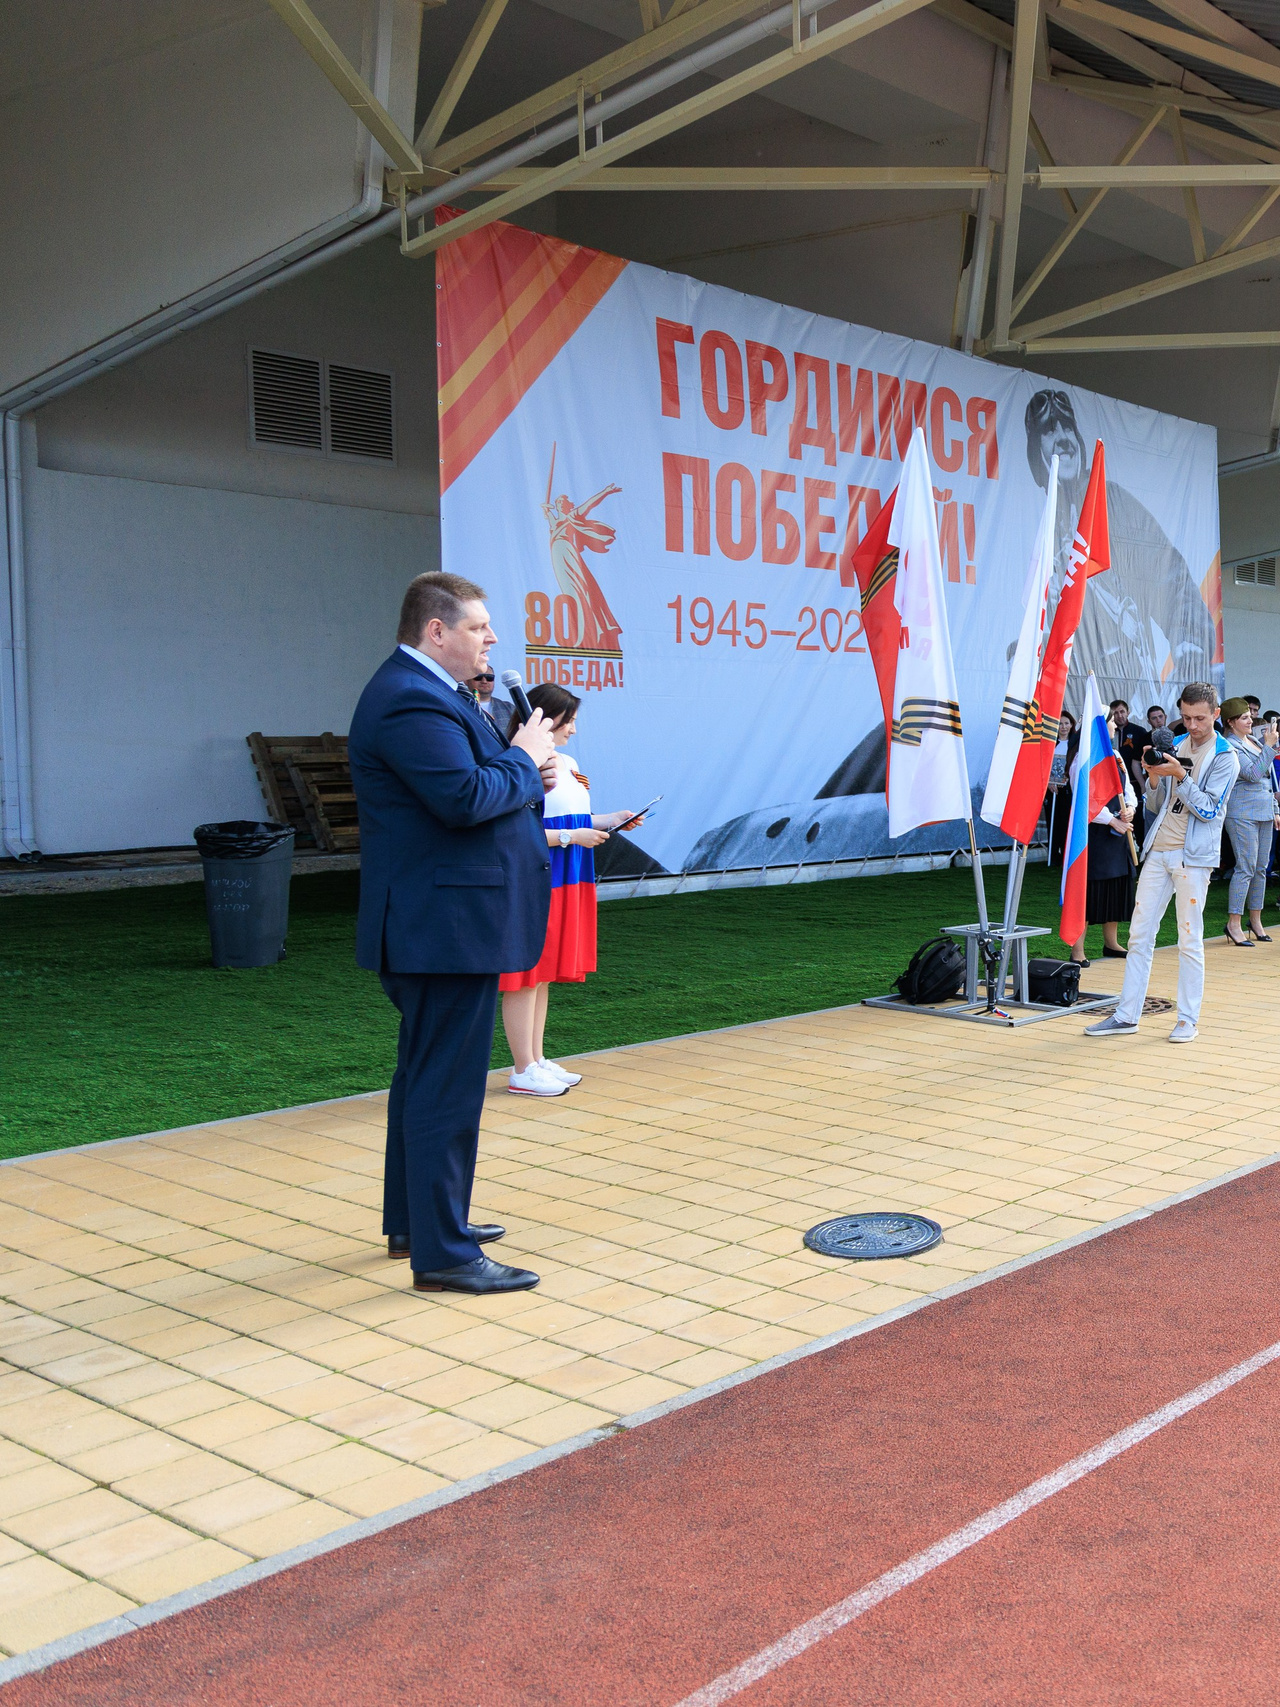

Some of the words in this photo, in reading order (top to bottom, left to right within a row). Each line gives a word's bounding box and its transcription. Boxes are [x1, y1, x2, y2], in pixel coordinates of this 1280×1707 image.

[656, 317, 999, 480] ГОРДИМСЯ
[662, 452, 977, 588] ПОБЕДЙ!
[525, 591, 578, 647] 80
[667, 594, 867, 654] 1945–202
[525, 657, 624, 692] ПОБЕДА!
